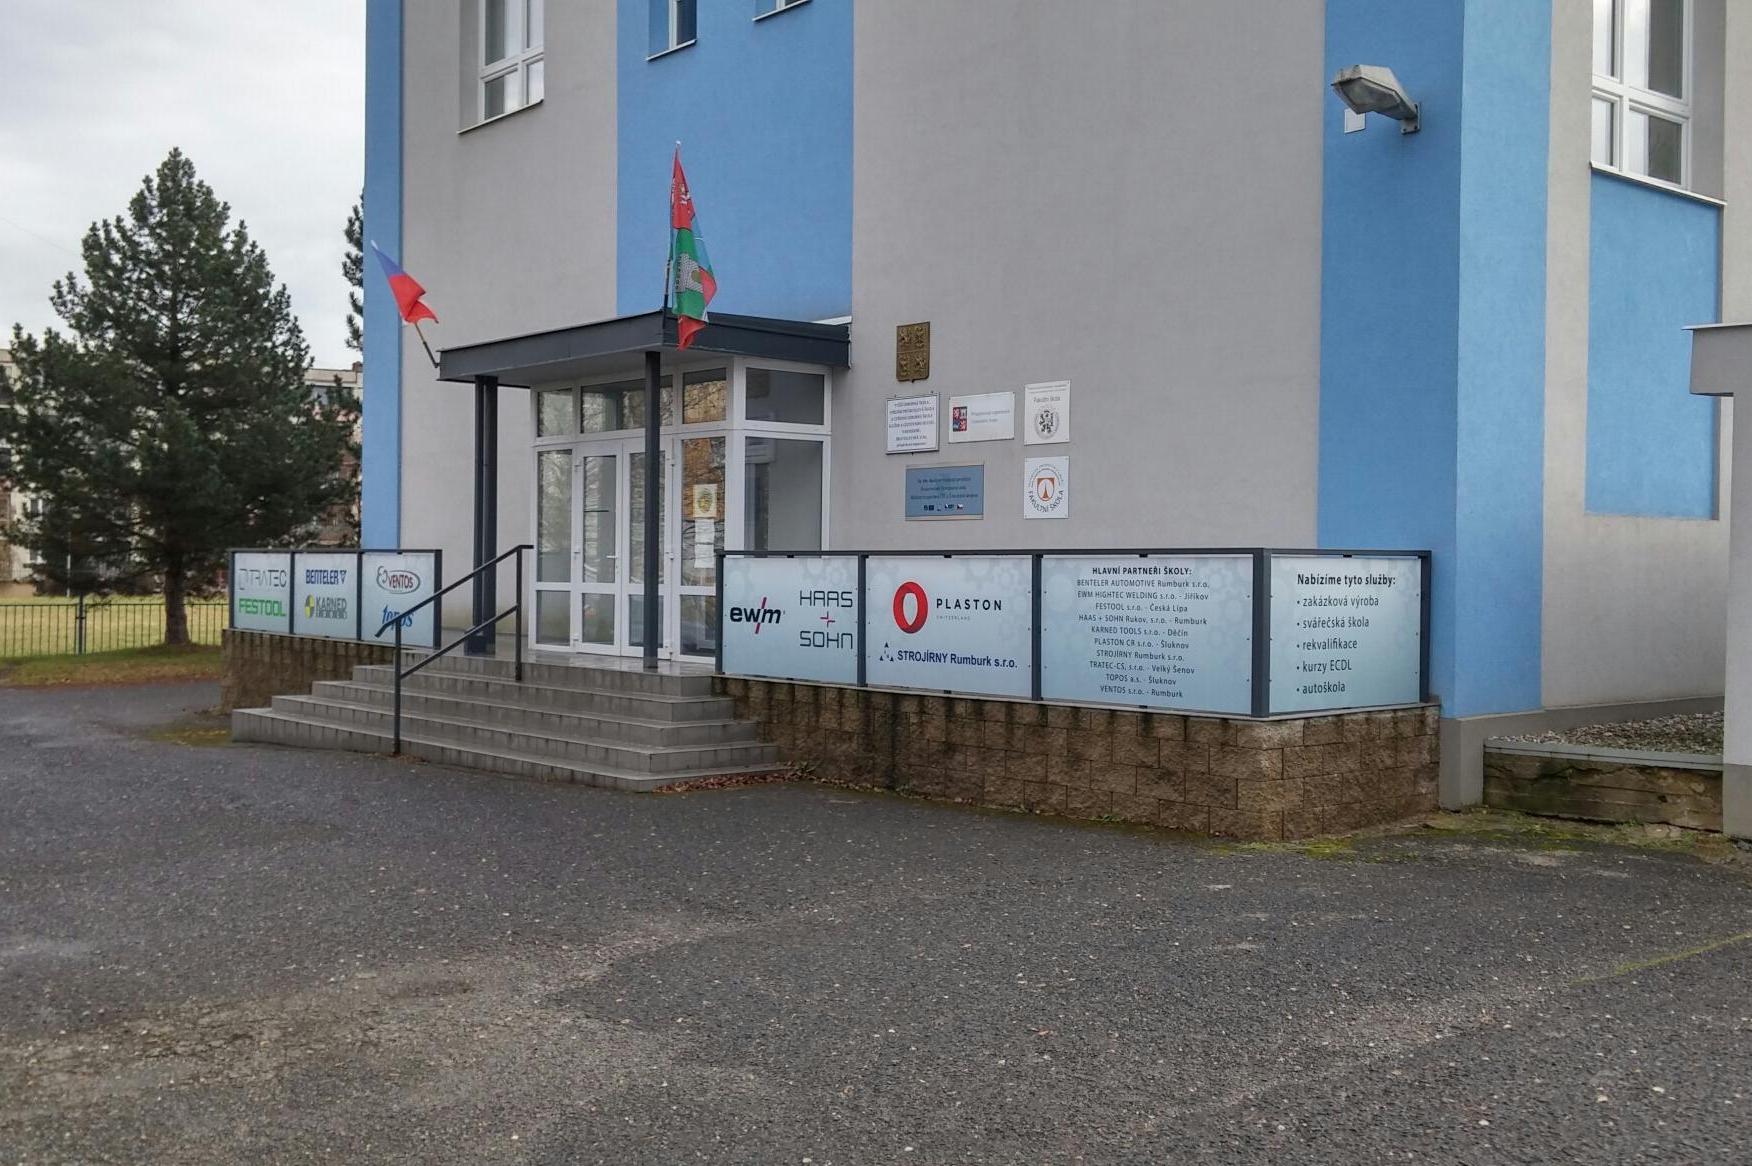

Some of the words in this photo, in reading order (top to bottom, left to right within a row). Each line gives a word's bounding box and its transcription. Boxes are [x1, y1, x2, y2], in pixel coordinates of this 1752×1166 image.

[305, 569, 339, 585] BENTELER
[1092, 566, 1120, 575] HLAVNÍ
[1122, 566, 1161, 575] PARTNEŘI
[1163, 566, 1193, 575] ŠKOLY:
[388, 574, 414, 589] VENTOS
[1076, 579, 1109, 587] BENTELER
[1110, 579, 1155, 588] AUTOMOTIVE
[1157, 580, 1190, 588] Rumburk
[1297, 573, 1342, 585] Nabízíme
[1344, 574, 1363, 588] tyto
[1364, 573, 1396, 588] služby:
[799, 590, 853, 608] HAAS
[1077, 590, 1093, 598] EWM
[1095, 591, 1124, 599] HIGHTEC
[1125, 591, 1158, 600] WELDING
[1302, 595, 1348, 607] zakázková
[1350, 594, 1379, 609] výroba
[238, 598, 287, 617] FESTOOL
[315, 596, 347, 611] KARNED
[936, 598, 1002, 611] PLASTON
[1095, 602, 1125, 611] FESTOOL
[1149, 603, 1171, 612] Česká
[729, 606, 781, 624] ewm
[1078, 614, 1097, 622] HAAS
[1104, 614, 1124, 623] SOHN
[1174, 616, 1208, 625] Rumburk
[1302, 616, 1346, 629] svářečská
[1347, 616, 1370, 628] škola
[1091, 625, 1118, 634] KARNED
[1120, 626, 1142, 635] TOOLS
[1167, 628, 1188, 637] Děčín
[1094, 637, 1125, 646] PLASTON
[1160, 639, 1189, 649] Šluknov
[1302, 638, 1358, 651] rekvalifikace
[897, 649, 948, 664] STROJÍRNY
[950, 653, 992, 667] Rumburk
[994, 657, 1018, 669] s.r.o.
[1134, 651, 1165, 660] Rumburk
[1151, 664, 1171, 674] Velký
[1172, 664, 1195, 674] Šenov
[1302, 660, 1328, 675] kurzy
[1329, 659, 1352, 672] ECDL
[1106, 673, 1128, 682] TOPOS
[1148, 675, 1177, 686] Šluknov
[1100, 685, 1126, 694] VENTOS
[1151, 688, 1184, 698] Rumburk
[1302, 681, 1346, 695] autoškola
